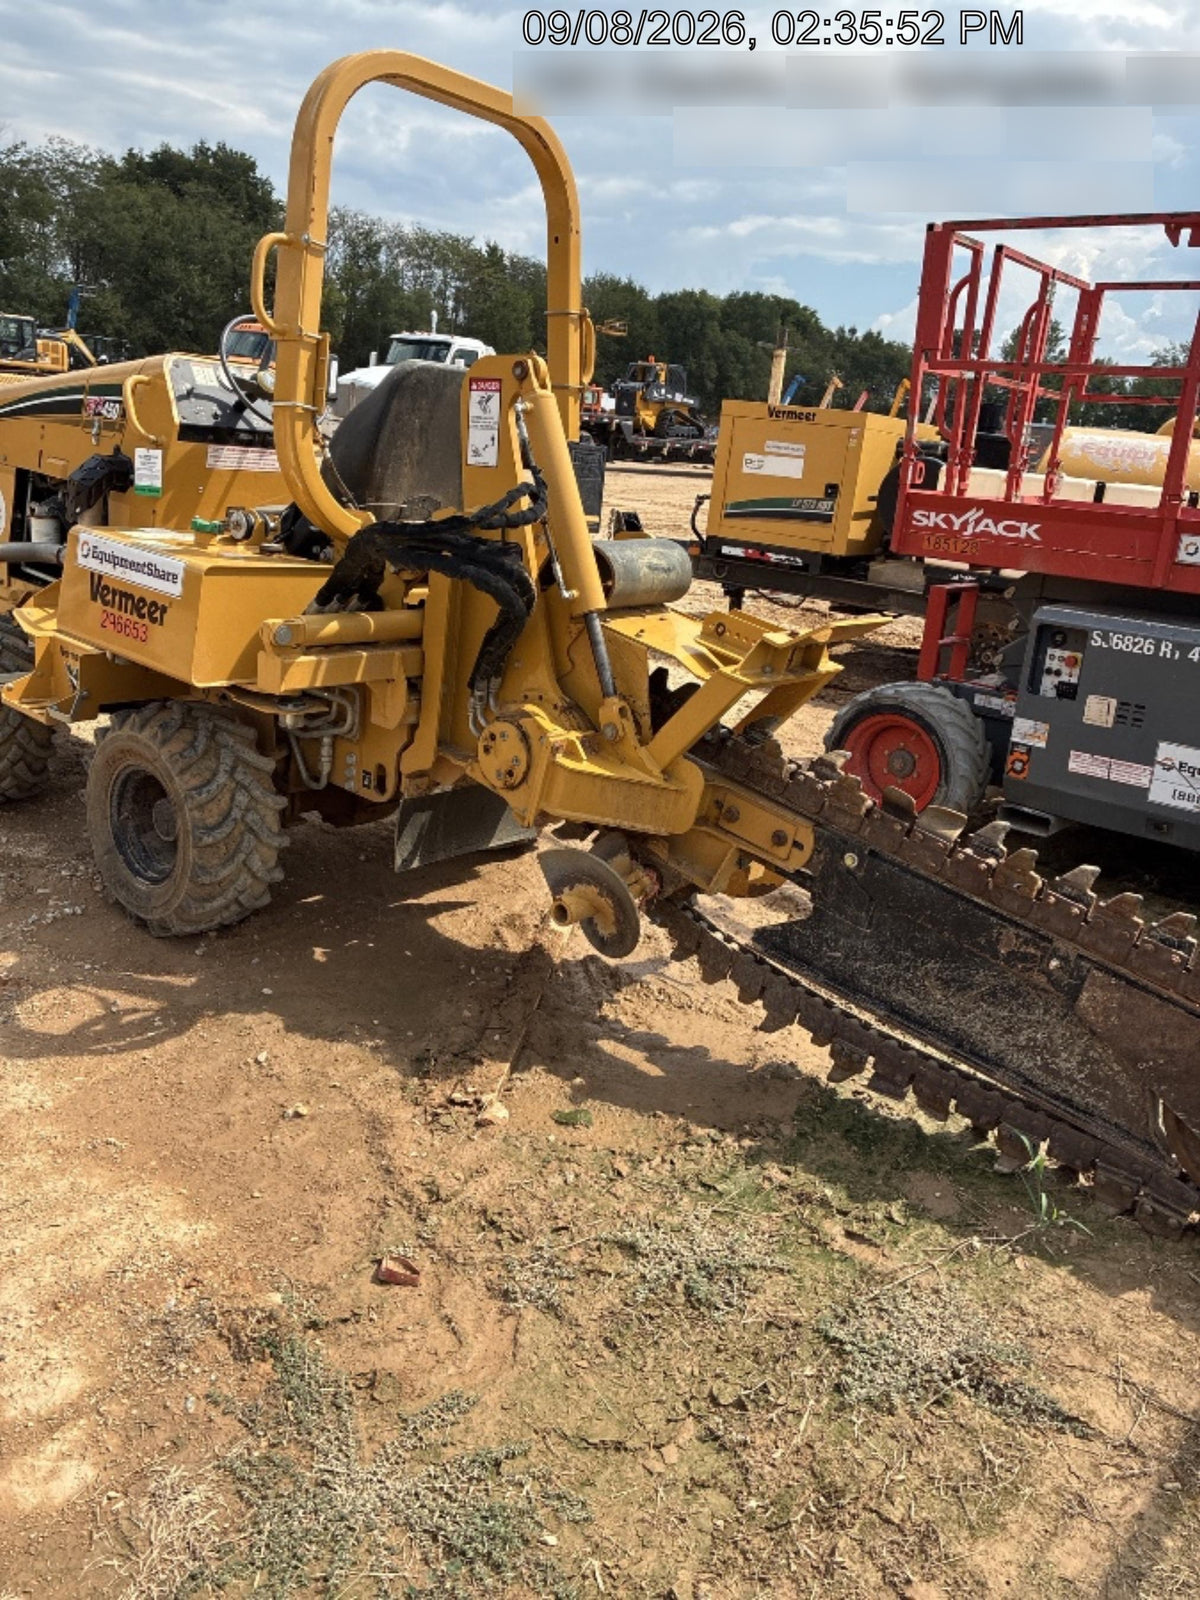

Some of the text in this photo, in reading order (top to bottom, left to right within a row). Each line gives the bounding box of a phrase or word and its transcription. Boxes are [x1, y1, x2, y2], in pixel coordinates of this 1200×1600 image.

[767, 404, 817, 422] Vermeer
[911, 507, 1042, 541] SKYJACK
[91, 545, 178, 584] EquipmentShare
[89, 571, 168, 627] Vermeer
[100, 608, 149, 643] 296653
